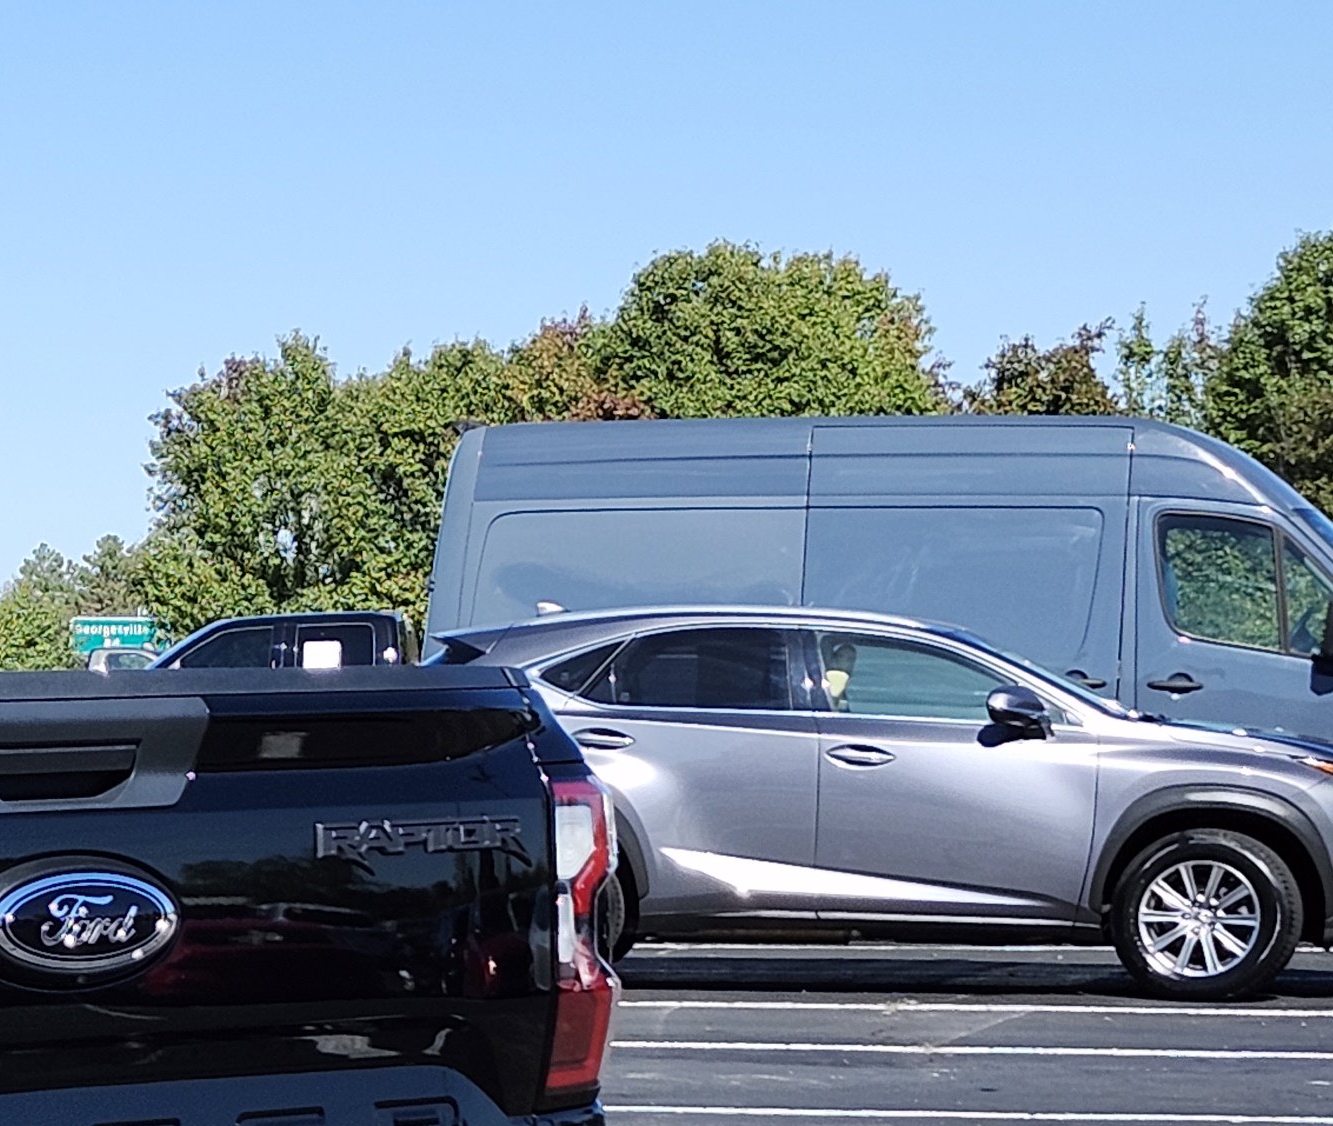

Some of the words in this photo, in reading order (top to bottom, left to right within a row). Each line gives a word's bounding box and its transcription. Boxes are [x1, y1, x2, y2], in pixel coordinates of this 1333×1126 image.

[74, 624, 150, 637] Georgesville
[314, 812, 532, 877] RAPTOR
[41, 894, 139, 947] Ford
